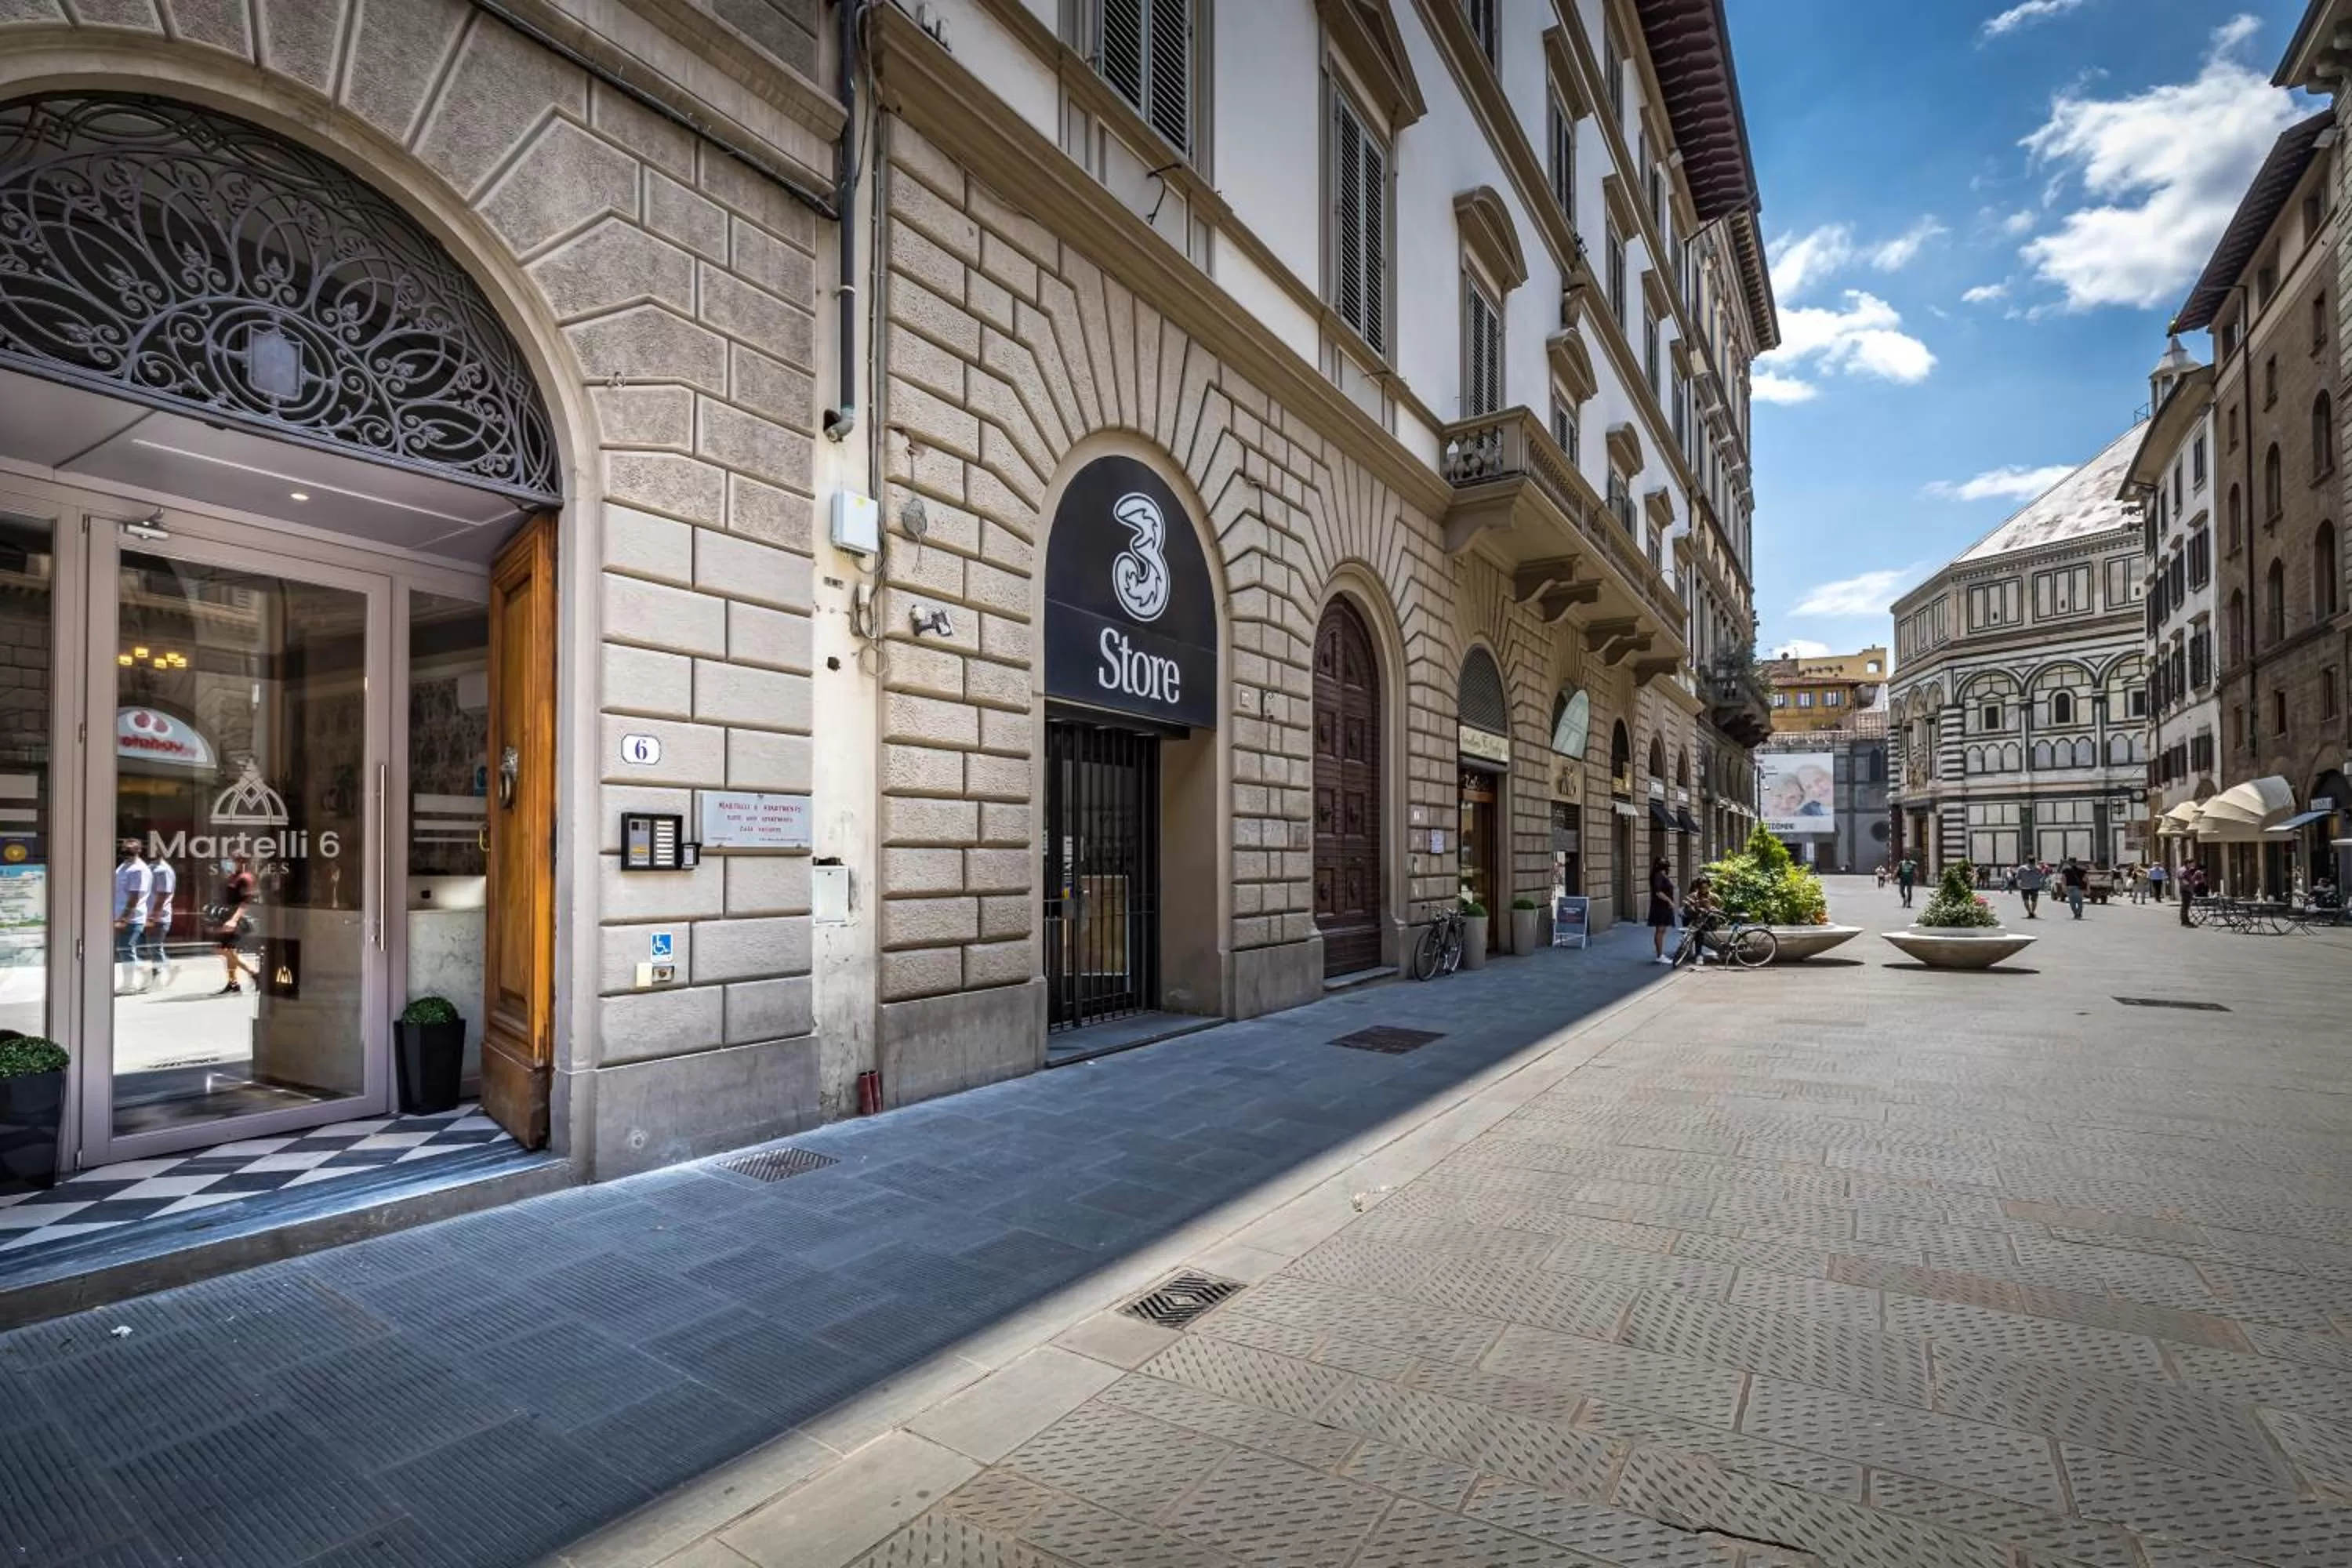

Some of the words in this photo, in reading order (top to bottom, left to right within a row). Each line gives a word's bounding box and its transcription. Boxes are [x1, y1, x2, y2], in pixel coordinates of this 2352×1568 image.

[1098, 626, 1180, 704] Store
[634, 739, 648, 760] 6
[147, 829, 309, 859] Martelli
[319, 830, 340, 858] 6
[208, 862, 290, 876] SITES
